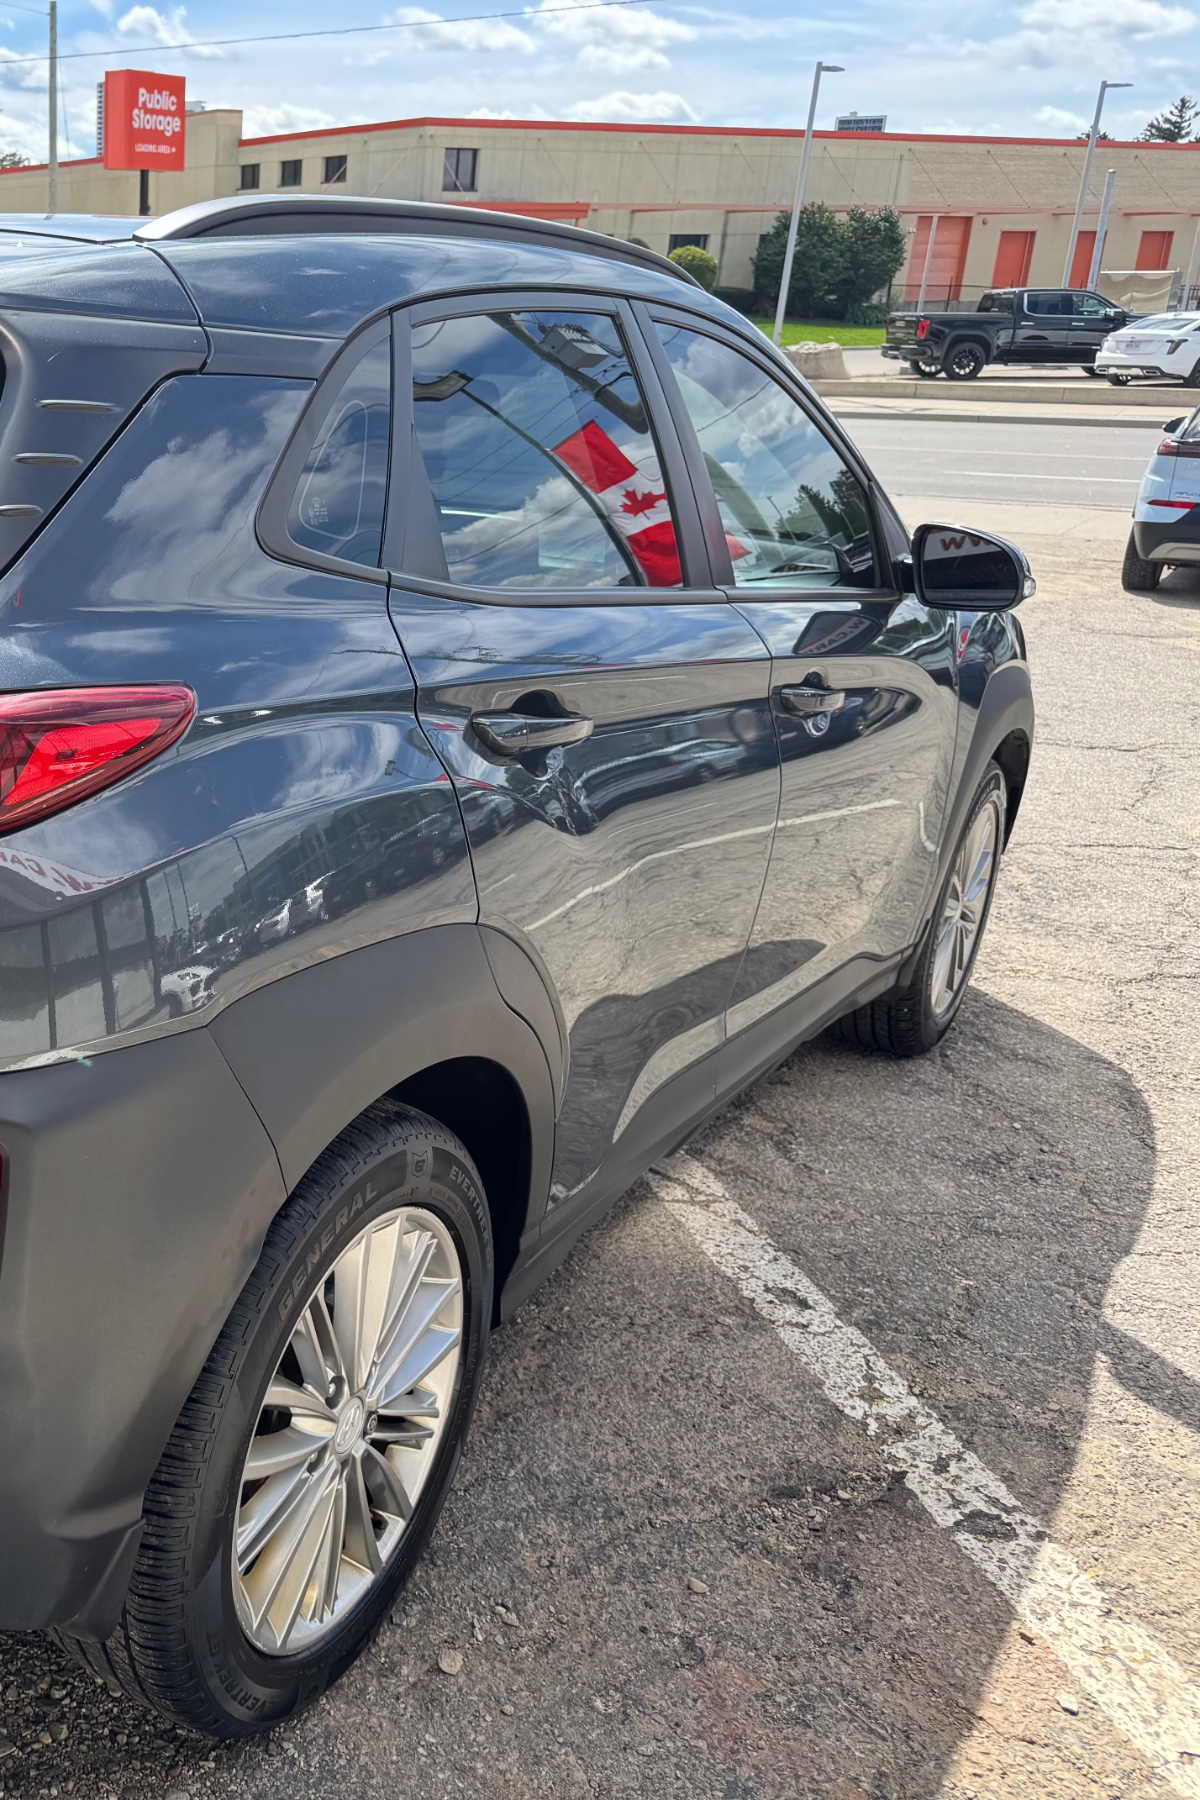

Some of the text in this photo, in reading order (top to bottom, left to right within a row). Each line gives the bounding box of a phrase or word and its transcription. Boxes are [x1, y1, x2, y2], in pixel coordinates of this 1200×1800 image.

[132, 109, 181, 137] Storage
[138, 87, 177, 111] Public
[448, 1164, 491, 1243] EVERTREK
[277, 1181, 378, 1321] GENERAL
